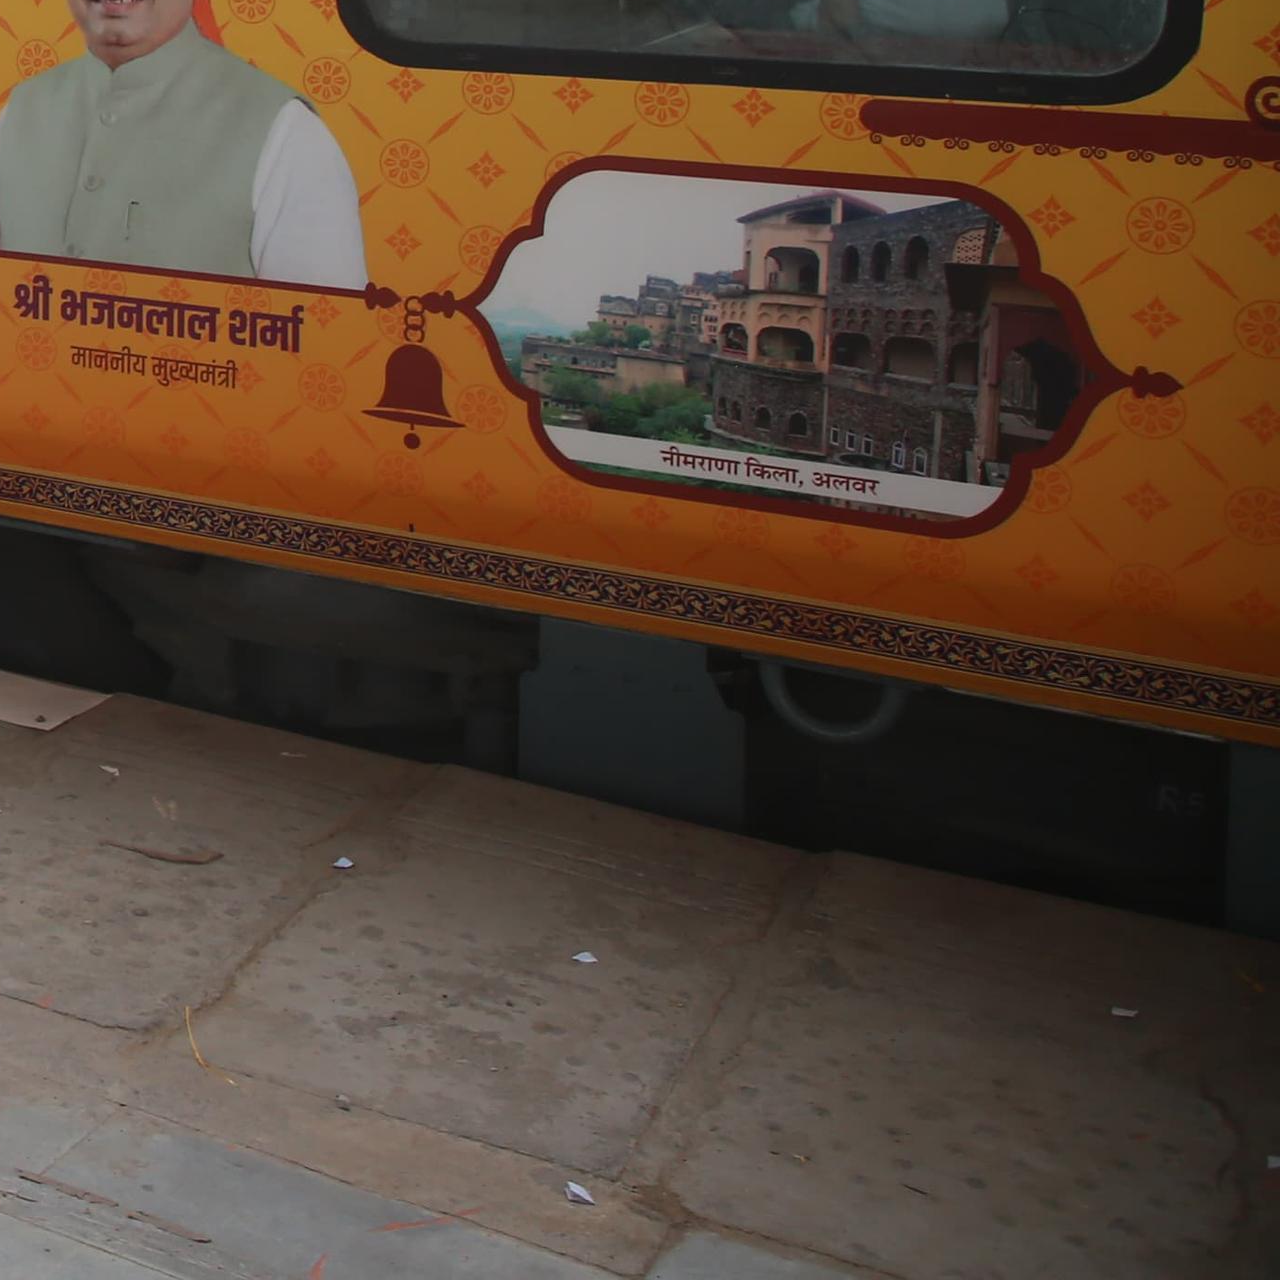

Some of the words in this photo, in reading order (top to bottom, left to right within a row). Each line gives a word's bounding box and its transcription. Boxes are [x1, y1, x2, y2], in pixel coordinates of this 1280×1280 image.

[13, 275, 53, 321] श्री
[60, 288, 220, 342] भजनलाल
[228, 305, 305, 353] शर्मा
[70, 345, 148, 377] माननीय
[151, 356, 239, 389] मुख्यमंत्री
[660, 446, 741, 477] नीमराणा
[744, 457, 804, 489] किला,
[811, 470, 880, 498] अलवर
